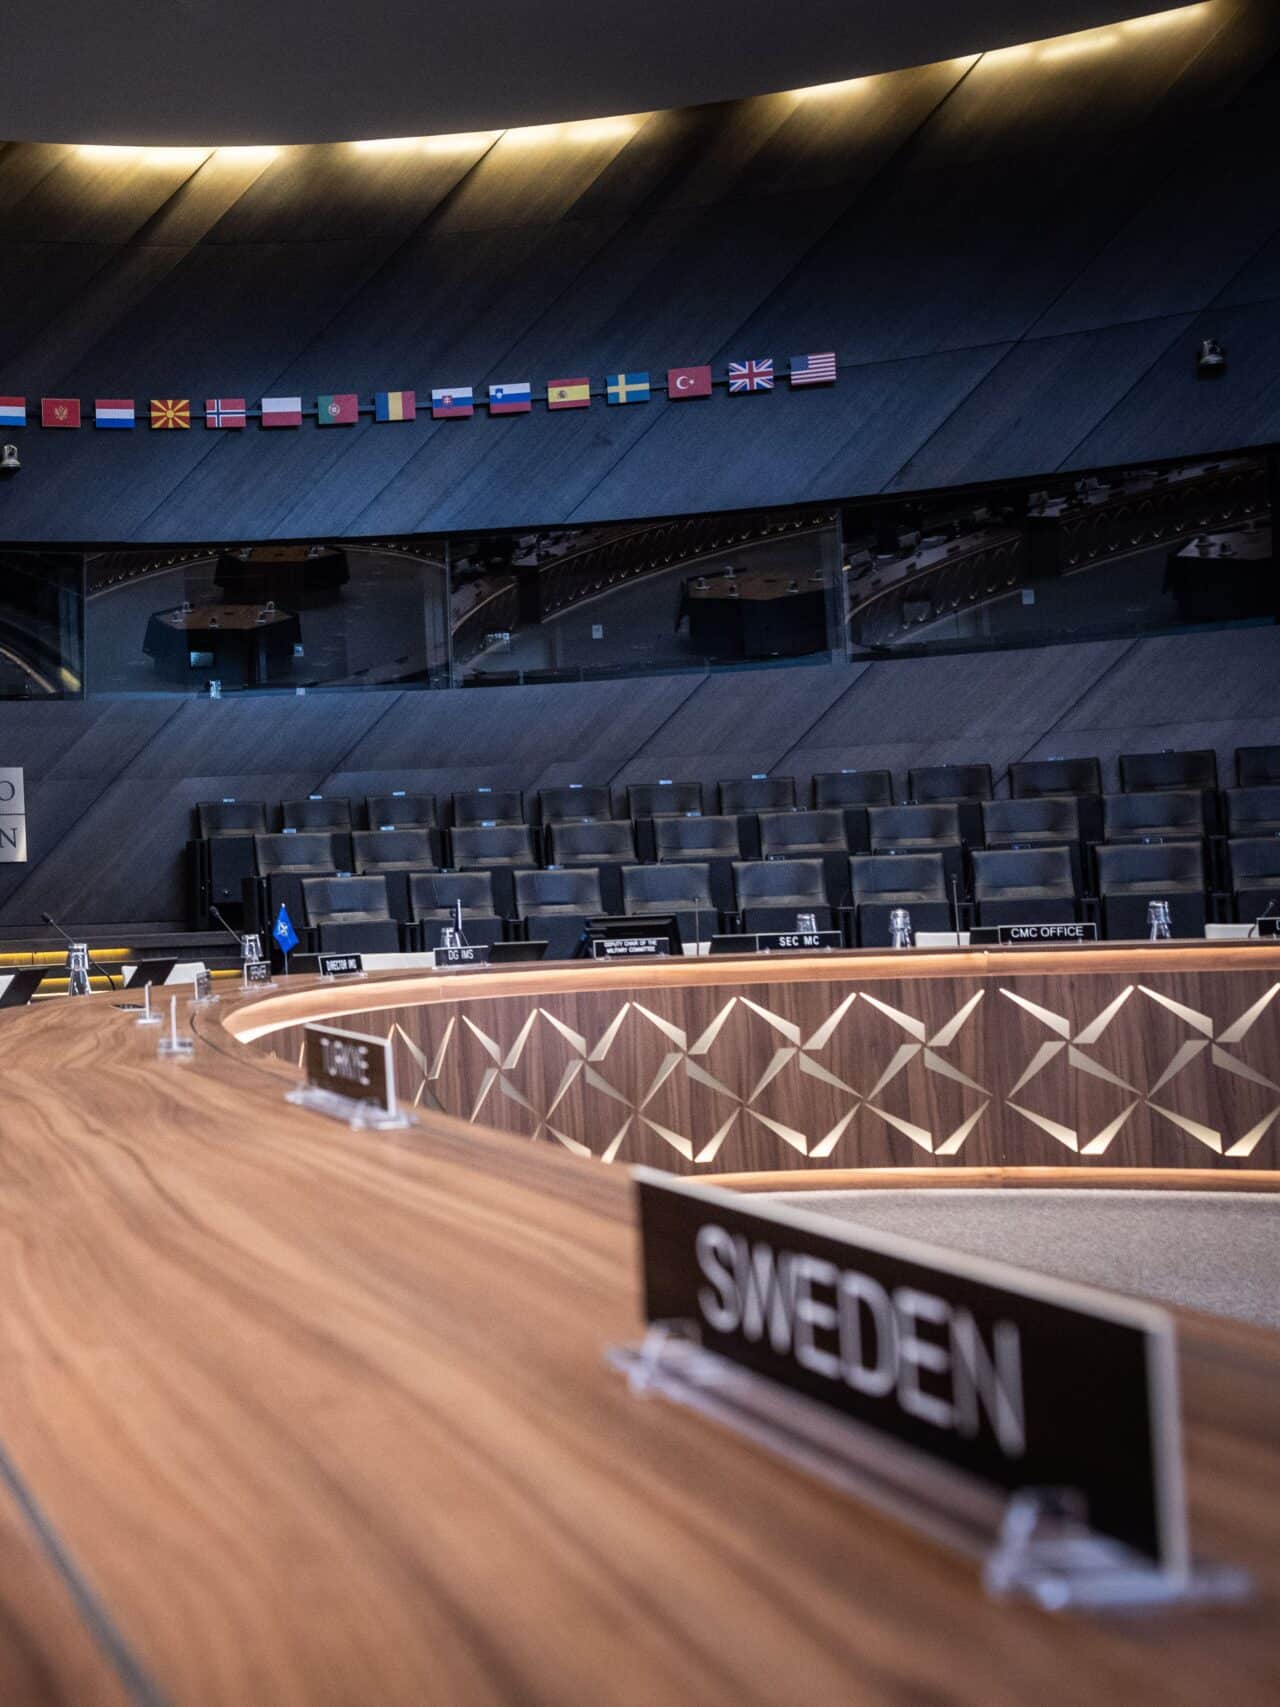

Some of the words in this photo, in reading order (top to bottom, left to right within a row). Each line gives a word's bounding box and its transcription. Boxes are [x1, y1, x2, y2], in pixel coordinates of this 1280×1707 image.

[1011, 927, 1038, 938] CMC
[1040, 926, 1084, 937] OFFICE
[779, 935, 799, 947] SEC
[803, 935, 820, 946] MC
[448, 950, 459, 961] DG
[696, 1223, 1025, 1458] SWEDEN
